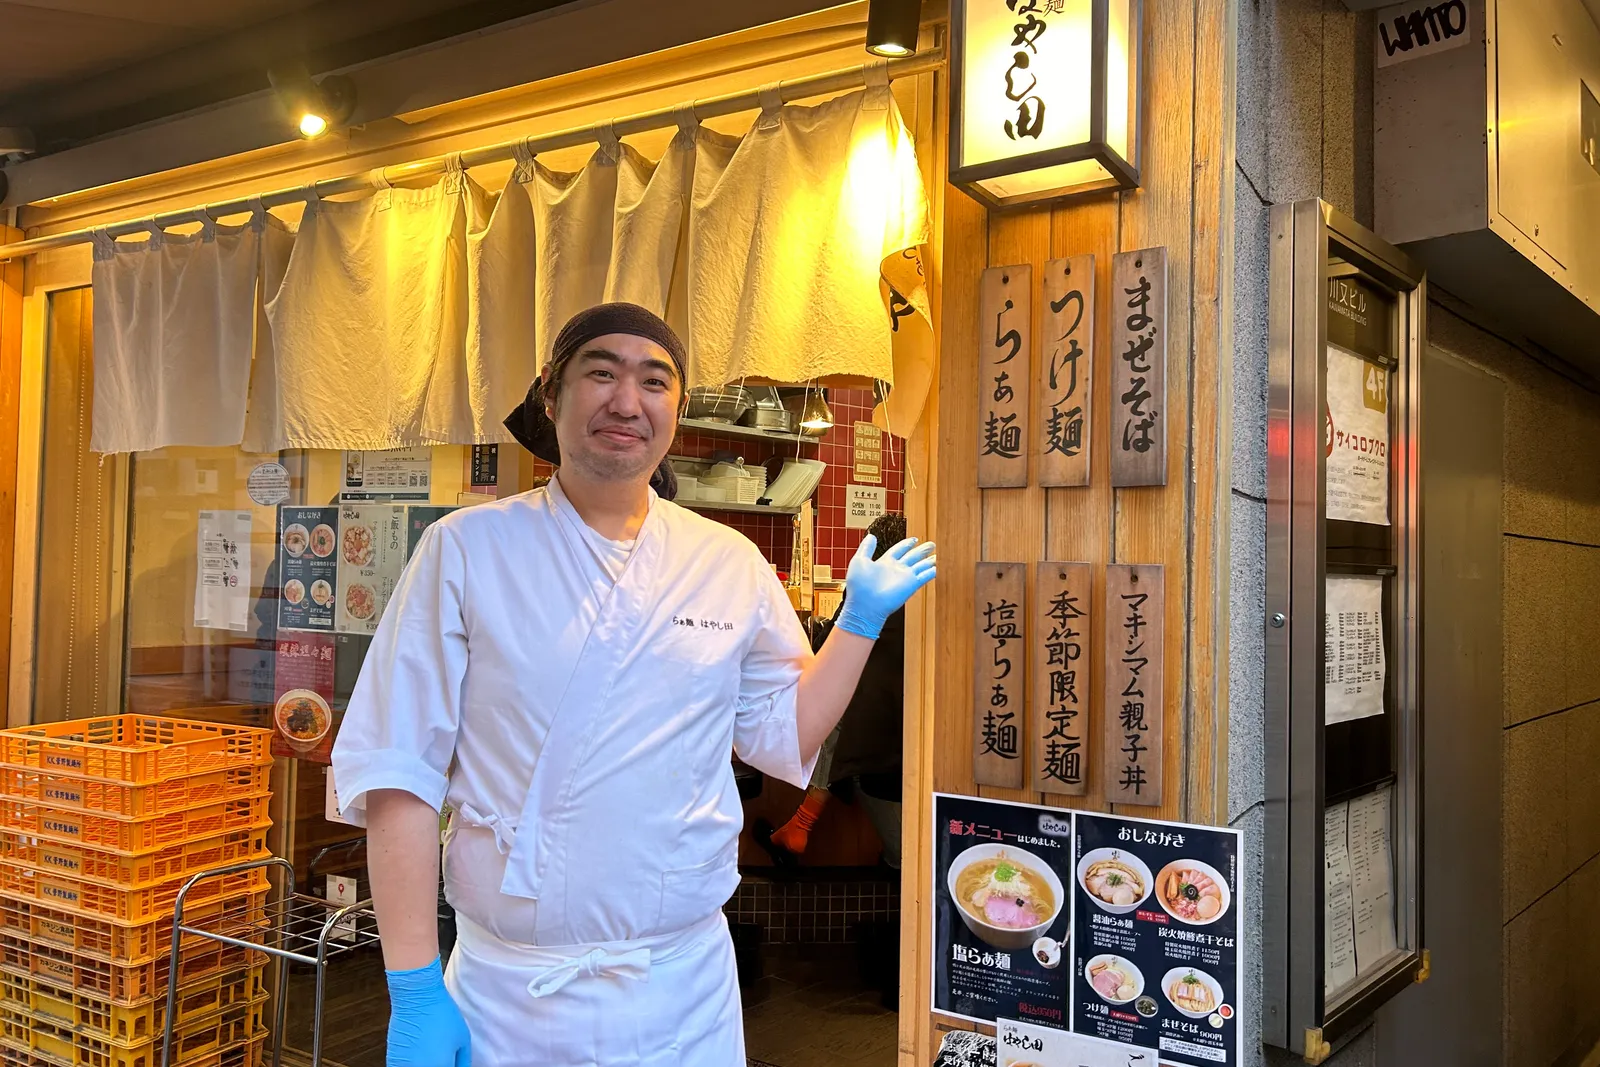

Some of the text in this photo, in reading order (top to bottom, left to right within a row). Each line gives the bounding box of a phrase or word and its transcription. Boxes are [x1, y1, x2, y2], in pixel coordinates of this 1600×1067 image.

[1329, 277, 1367, 313] 川又ビル
[1044, 289, 1084, 457] つけ麺
[1121, 276, 1158, 453] まぜそば
[981, 299, 1023, 459] らぁ麺
[1366, 366, 1385, 402] 4F
[851, 501, 865, 509] OPEN
[851, 509, 867, 517] CLOSE
[672, 616, 734, 630] らぁ麺 はやし田
[980, 598, 1023, 760] 塩らぁ麺
[1041, 590, 1087, 784] 季節限定麺
[949, 818, 1017, 841] 新メニュー
[1118, 826, 1186, 848] おしながき
[952, 943, 1011, 971] 塩らぁ麺
[1082, 1002, 1109, 1015] つけ麺
[1161, 1018, 1199, 1034] まぜそば
